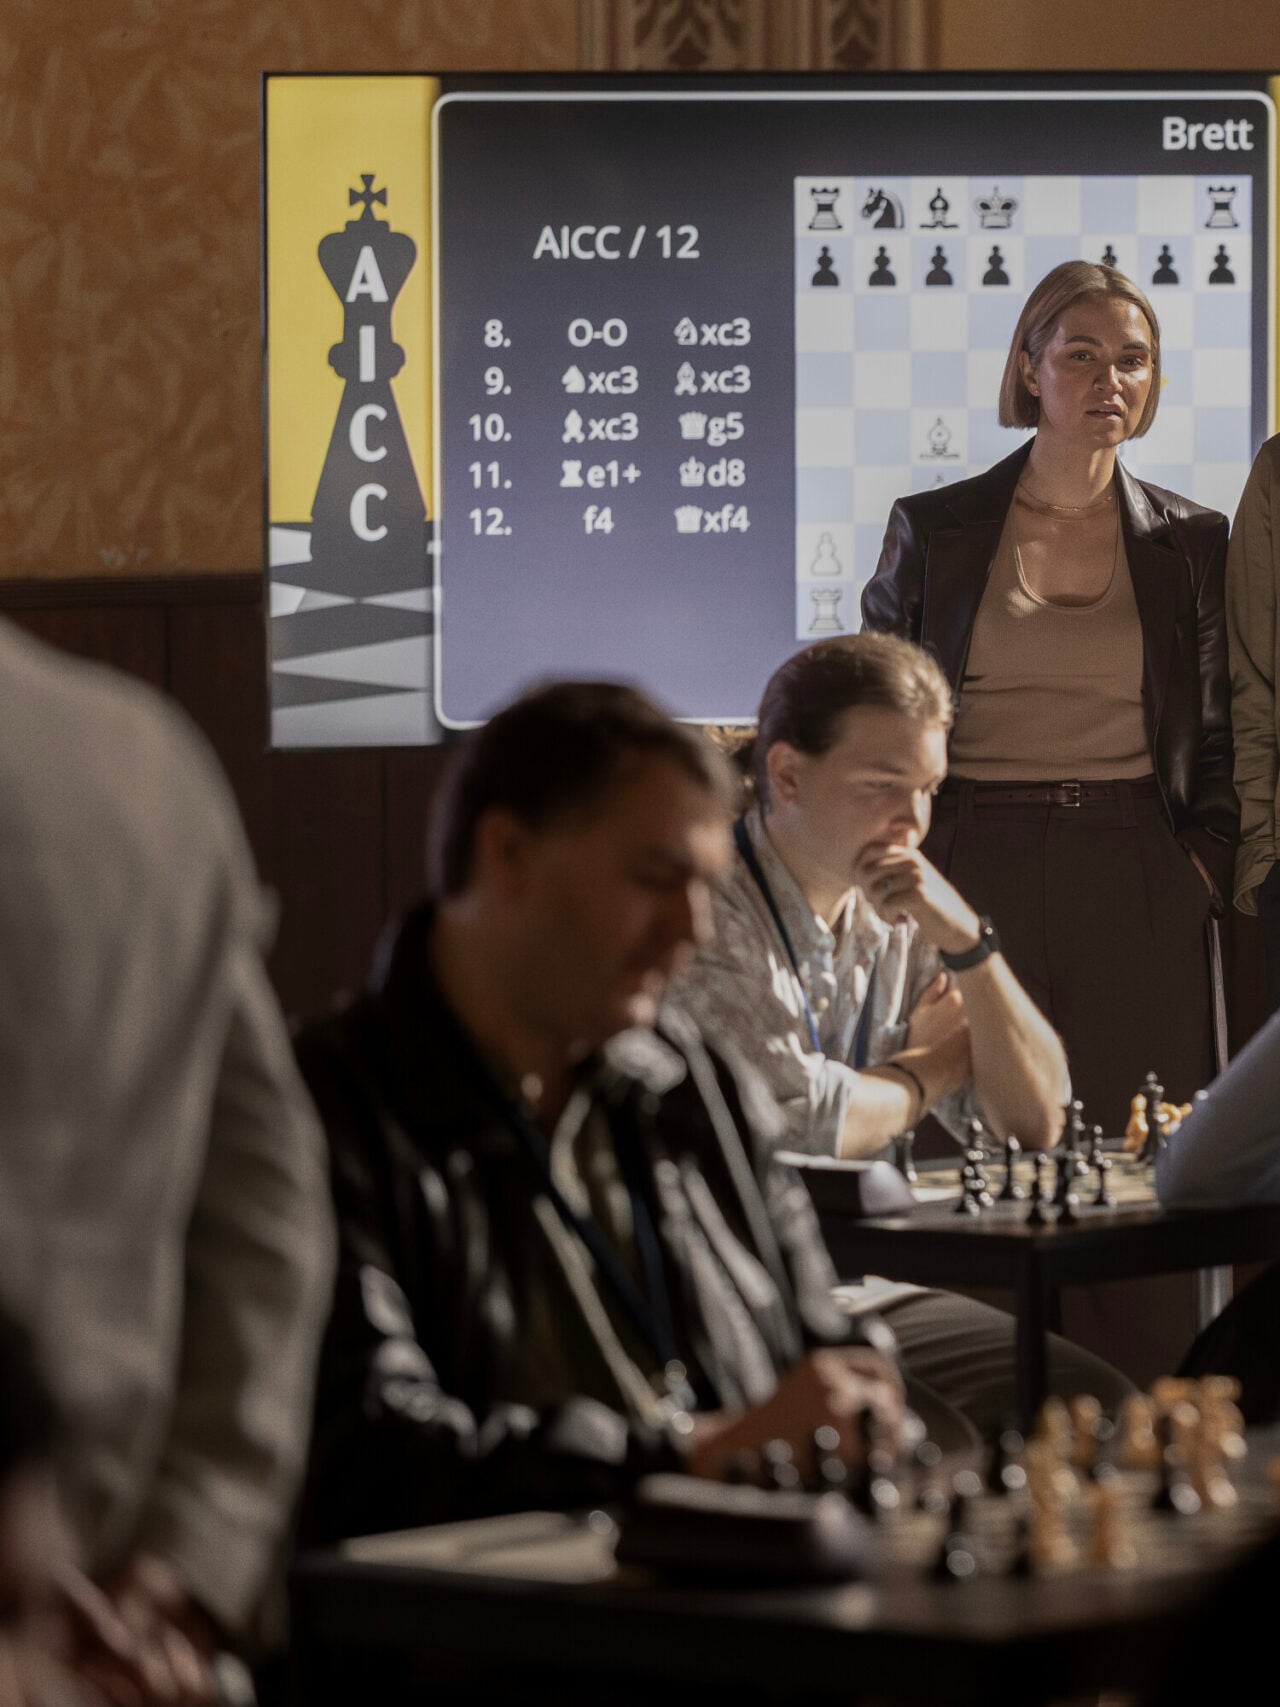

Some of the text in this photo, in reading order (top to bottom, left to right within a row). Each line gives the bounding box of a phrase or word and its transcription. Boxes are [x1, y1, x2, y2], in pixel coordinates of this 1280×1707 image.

[1162, 116, 1254, 151] Brett
[532, 225, 700, 260] AICC / 12
[484, 319, 511, 347] 8.
[484, 366, 511, 395] 9.
[469, 413, 512, 442] 10.
[469, 461, 512, 489] 11.
[469, 507, 512, 535] 12.
[583, 505, 614, 534] f4
